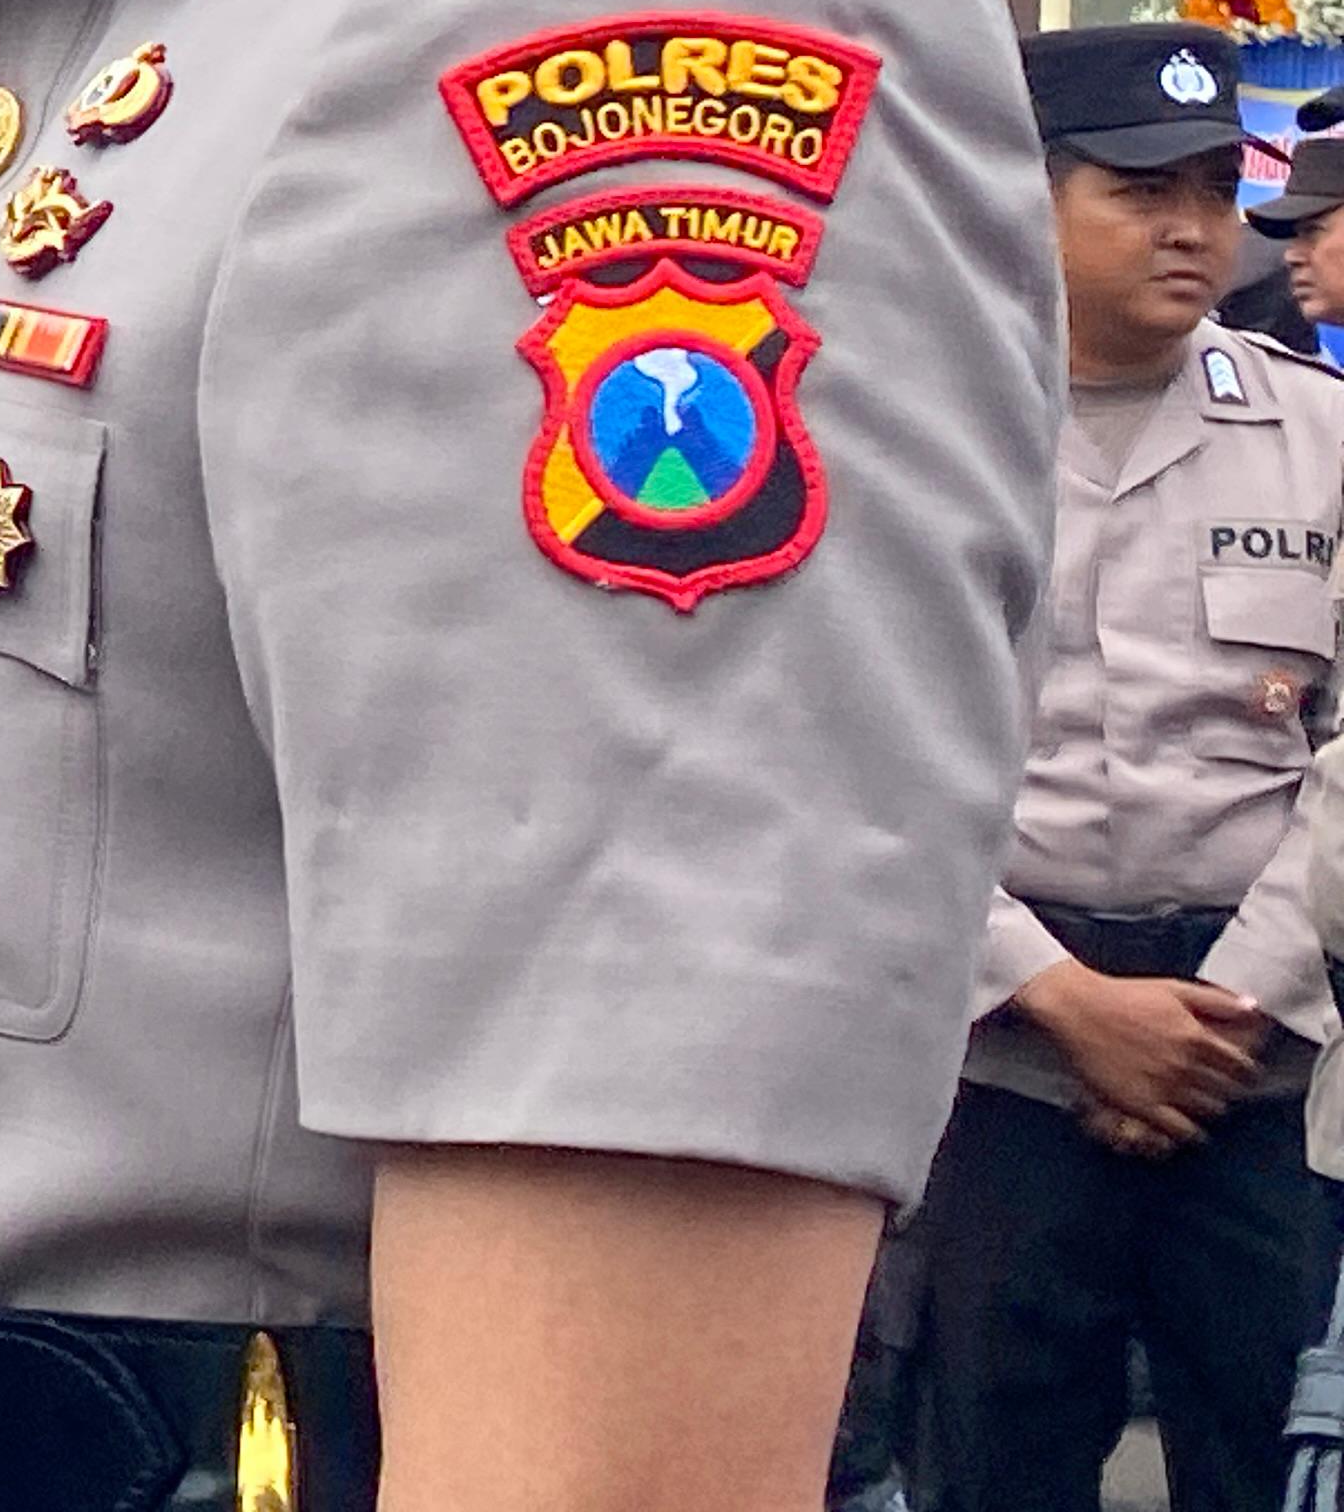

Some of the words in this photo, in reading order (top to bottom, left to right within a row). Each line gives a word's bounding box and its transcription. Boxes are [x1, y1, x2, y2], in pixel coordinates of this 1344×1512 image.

[475, 36, 843, 126] POLRES
[499, 94, 824, 174] BOJONEGORO
[537, 209, 652, 269] JAWA
[660, 206, 800, 260] TIMUR
[1209, 526, 1334, 568] POLRI
